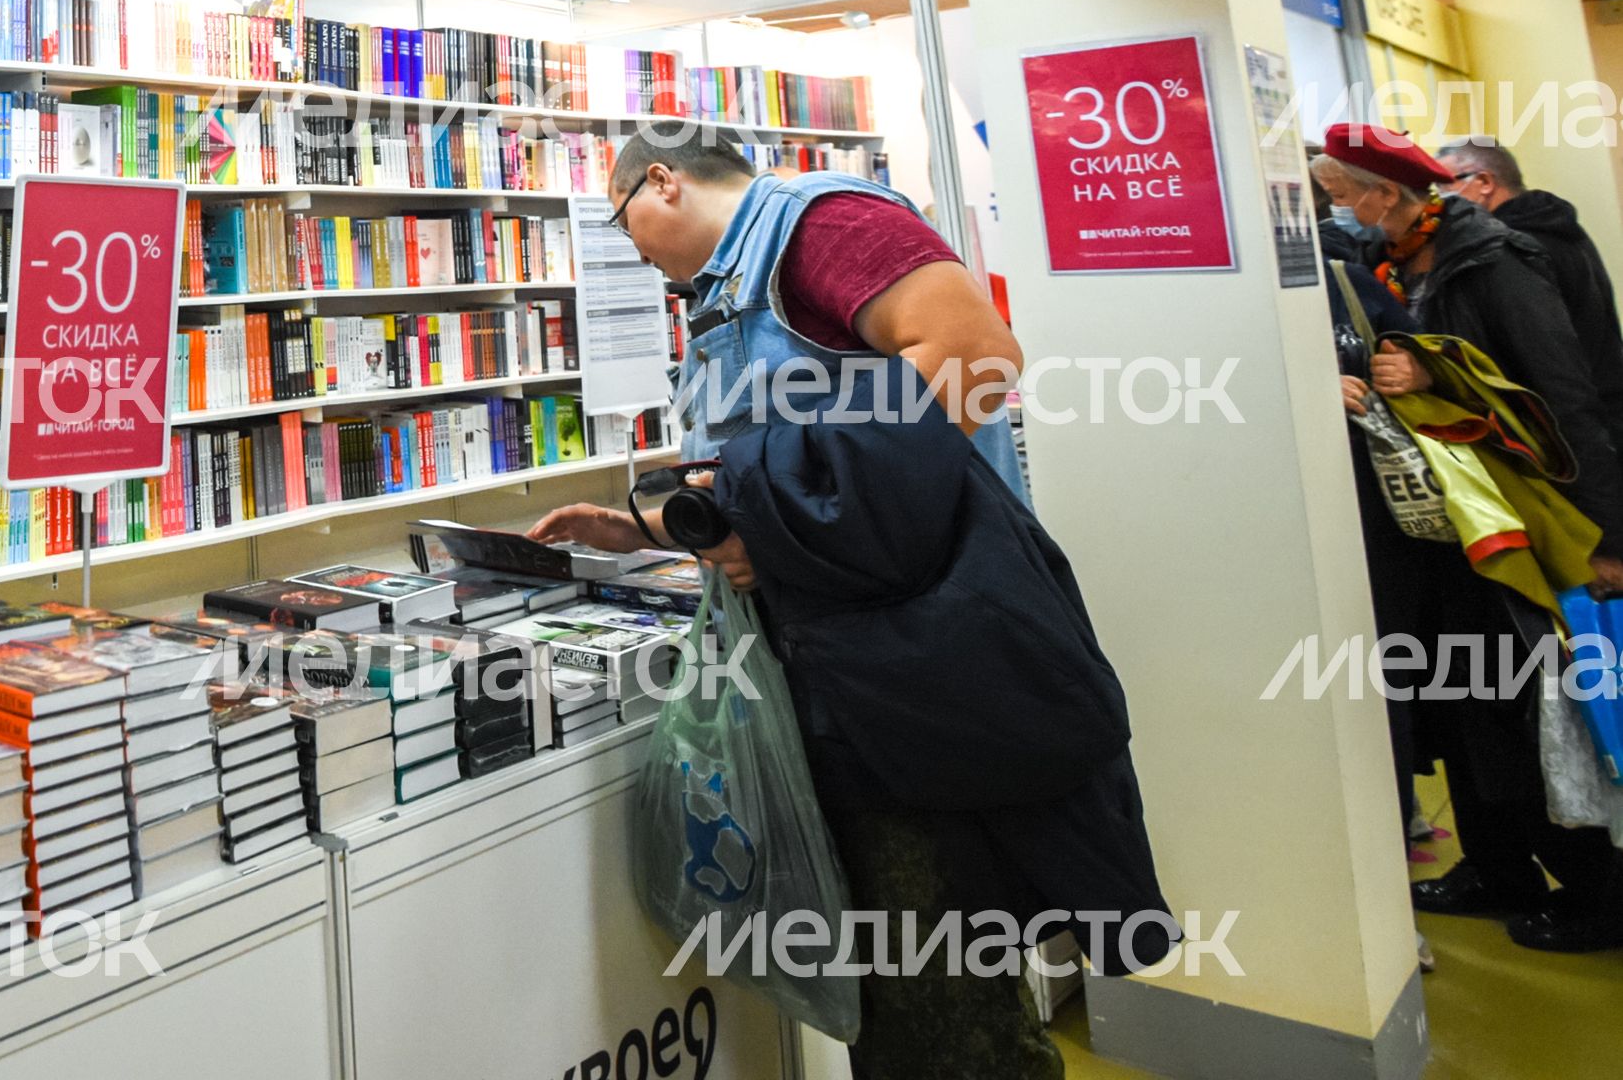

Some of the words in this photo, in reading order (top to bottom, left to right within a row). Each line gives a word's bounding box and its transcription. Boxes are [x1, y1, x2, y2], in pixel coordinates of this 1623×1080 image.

[1070, 151, 1181, 176] СКИДКА
[1073, 183, 1116, 201] НА
[1127, 175, 1184, 199] ВСЁ
[43, 324, 139, 350] СКИДКА
[41, 360, 78, 384] НА
[90, 354, 136, 381] ВСЁ
